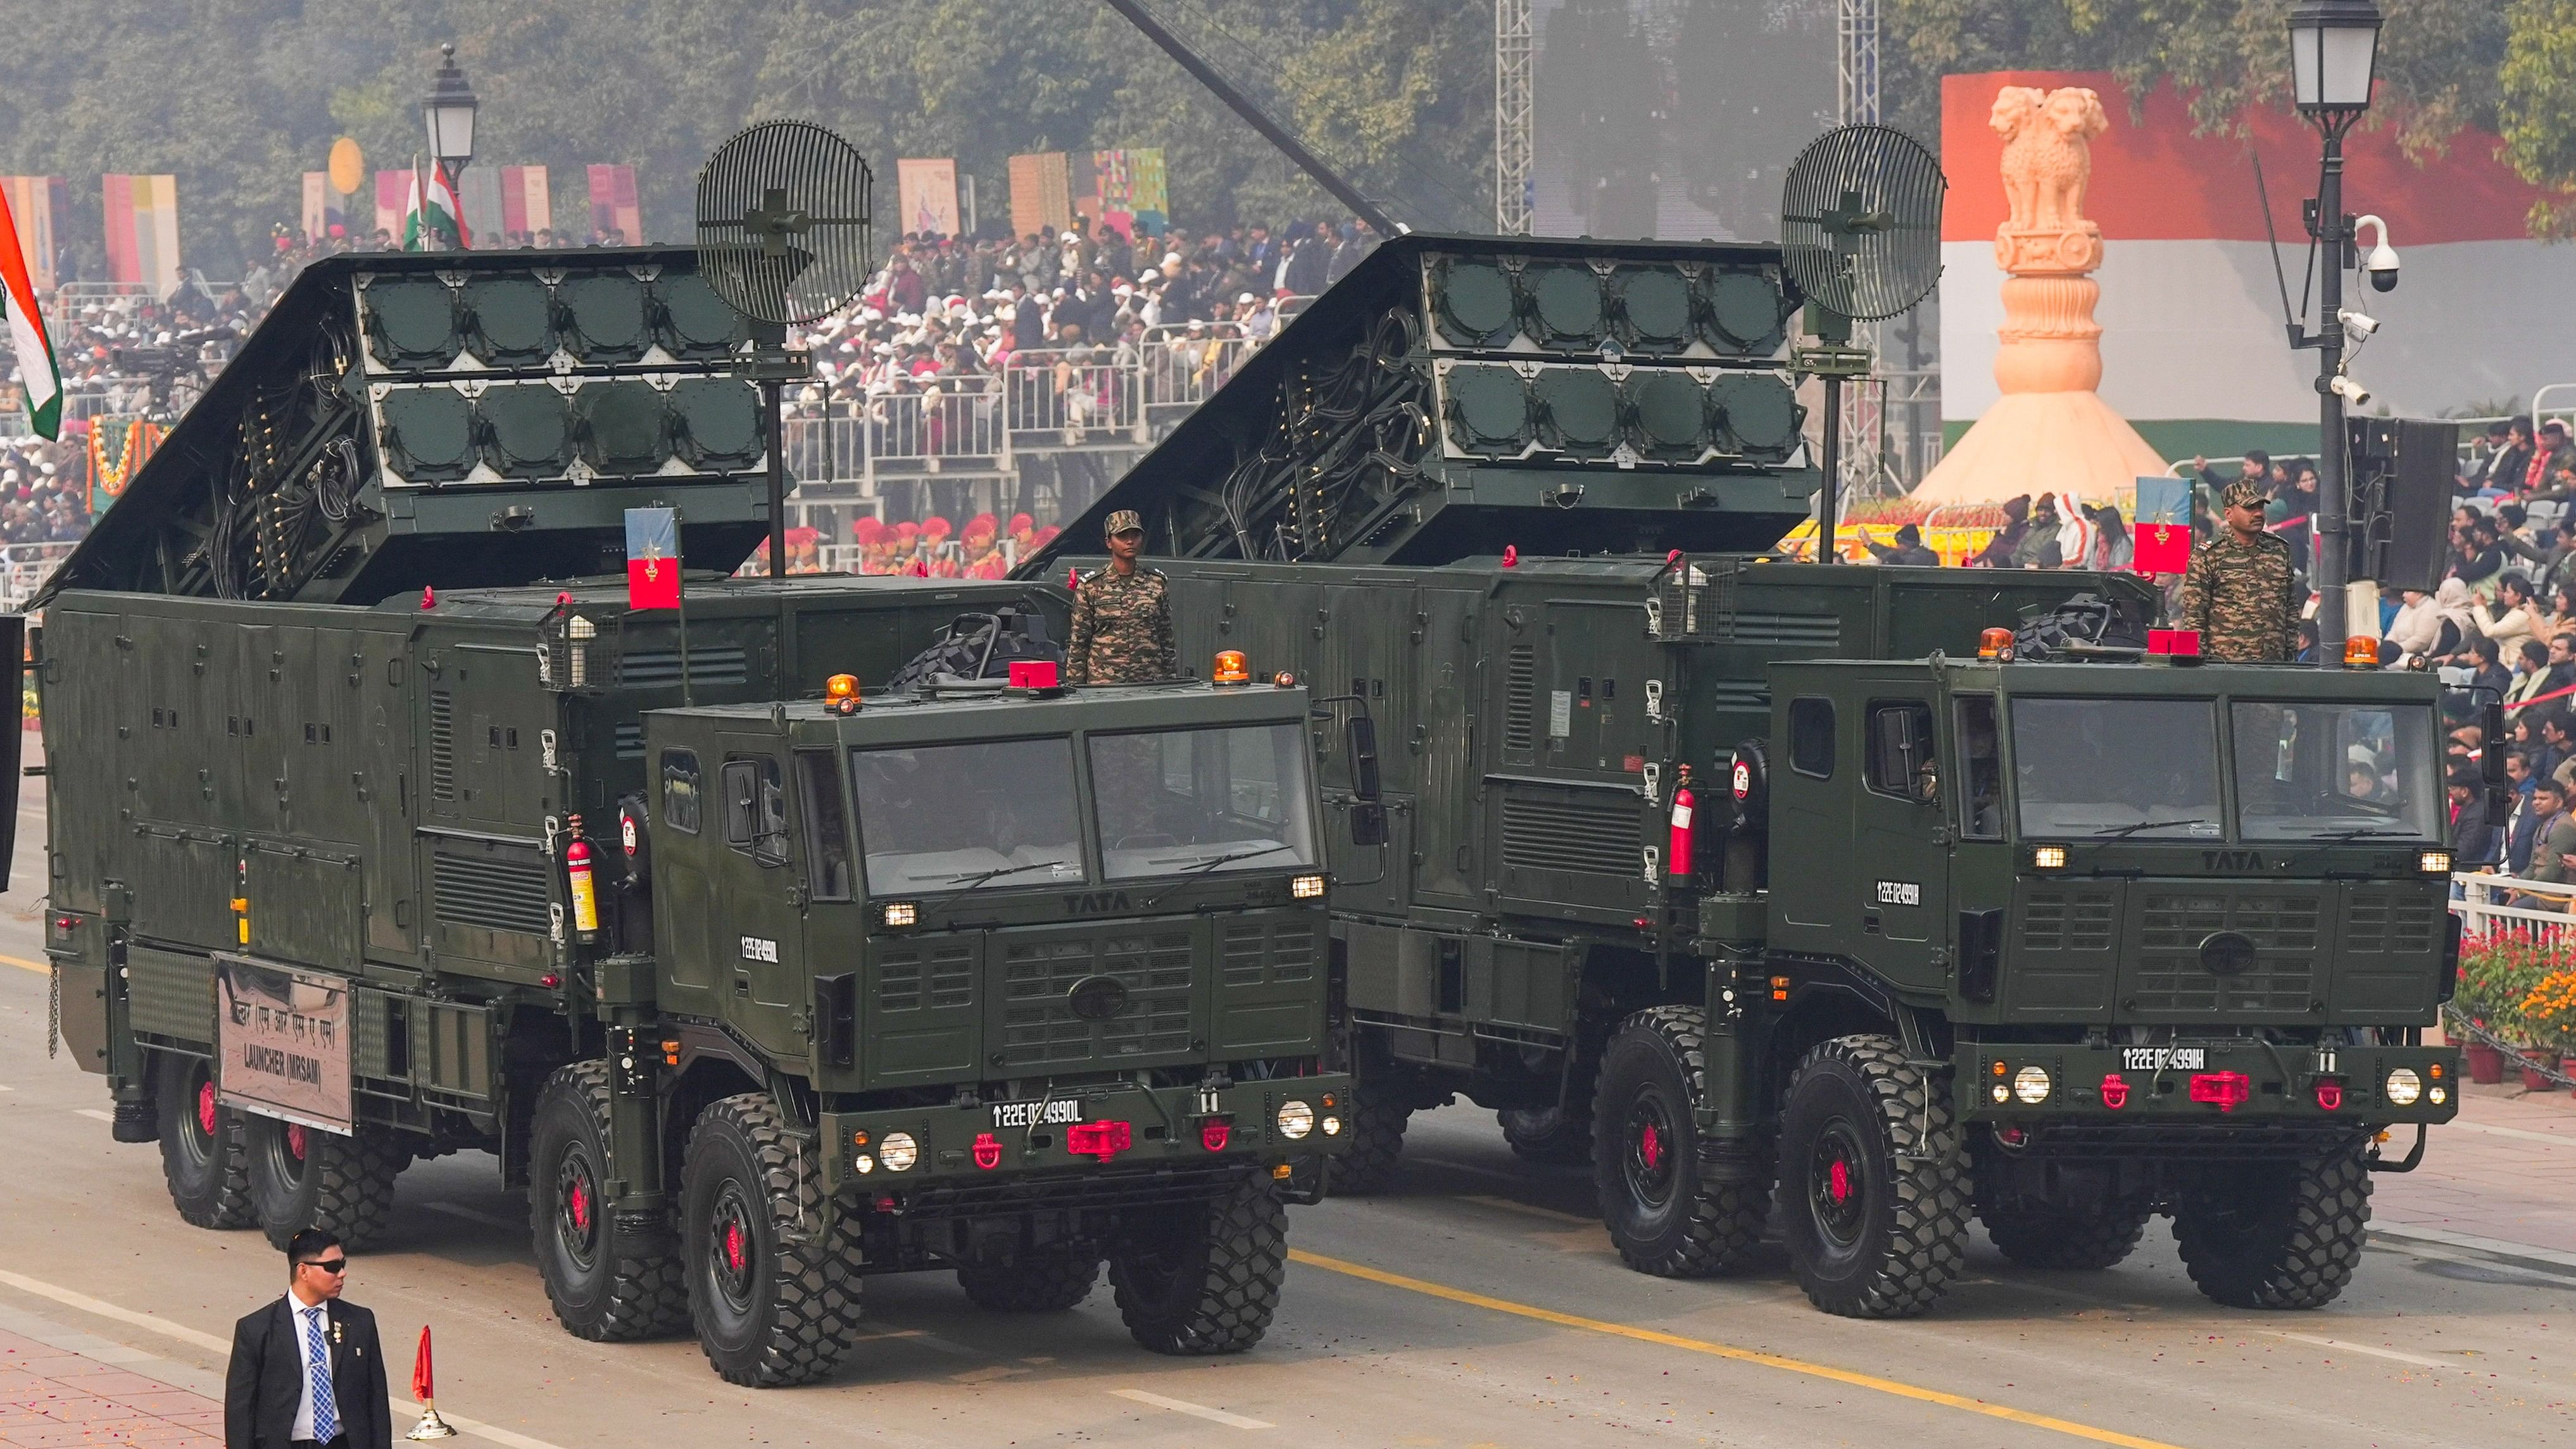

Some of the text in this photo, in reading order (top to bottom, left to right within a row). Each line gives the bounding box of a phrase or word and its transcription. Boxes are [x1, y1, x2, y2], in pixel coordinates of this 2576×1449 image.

[2201, 851, 2265, 870] TATA
[1064, 891, 1130, 912] TATA
[274, 1010, 288, 1035] आर
[244, 1043, 321, 1093] LAUNCHER (MRSAM)
